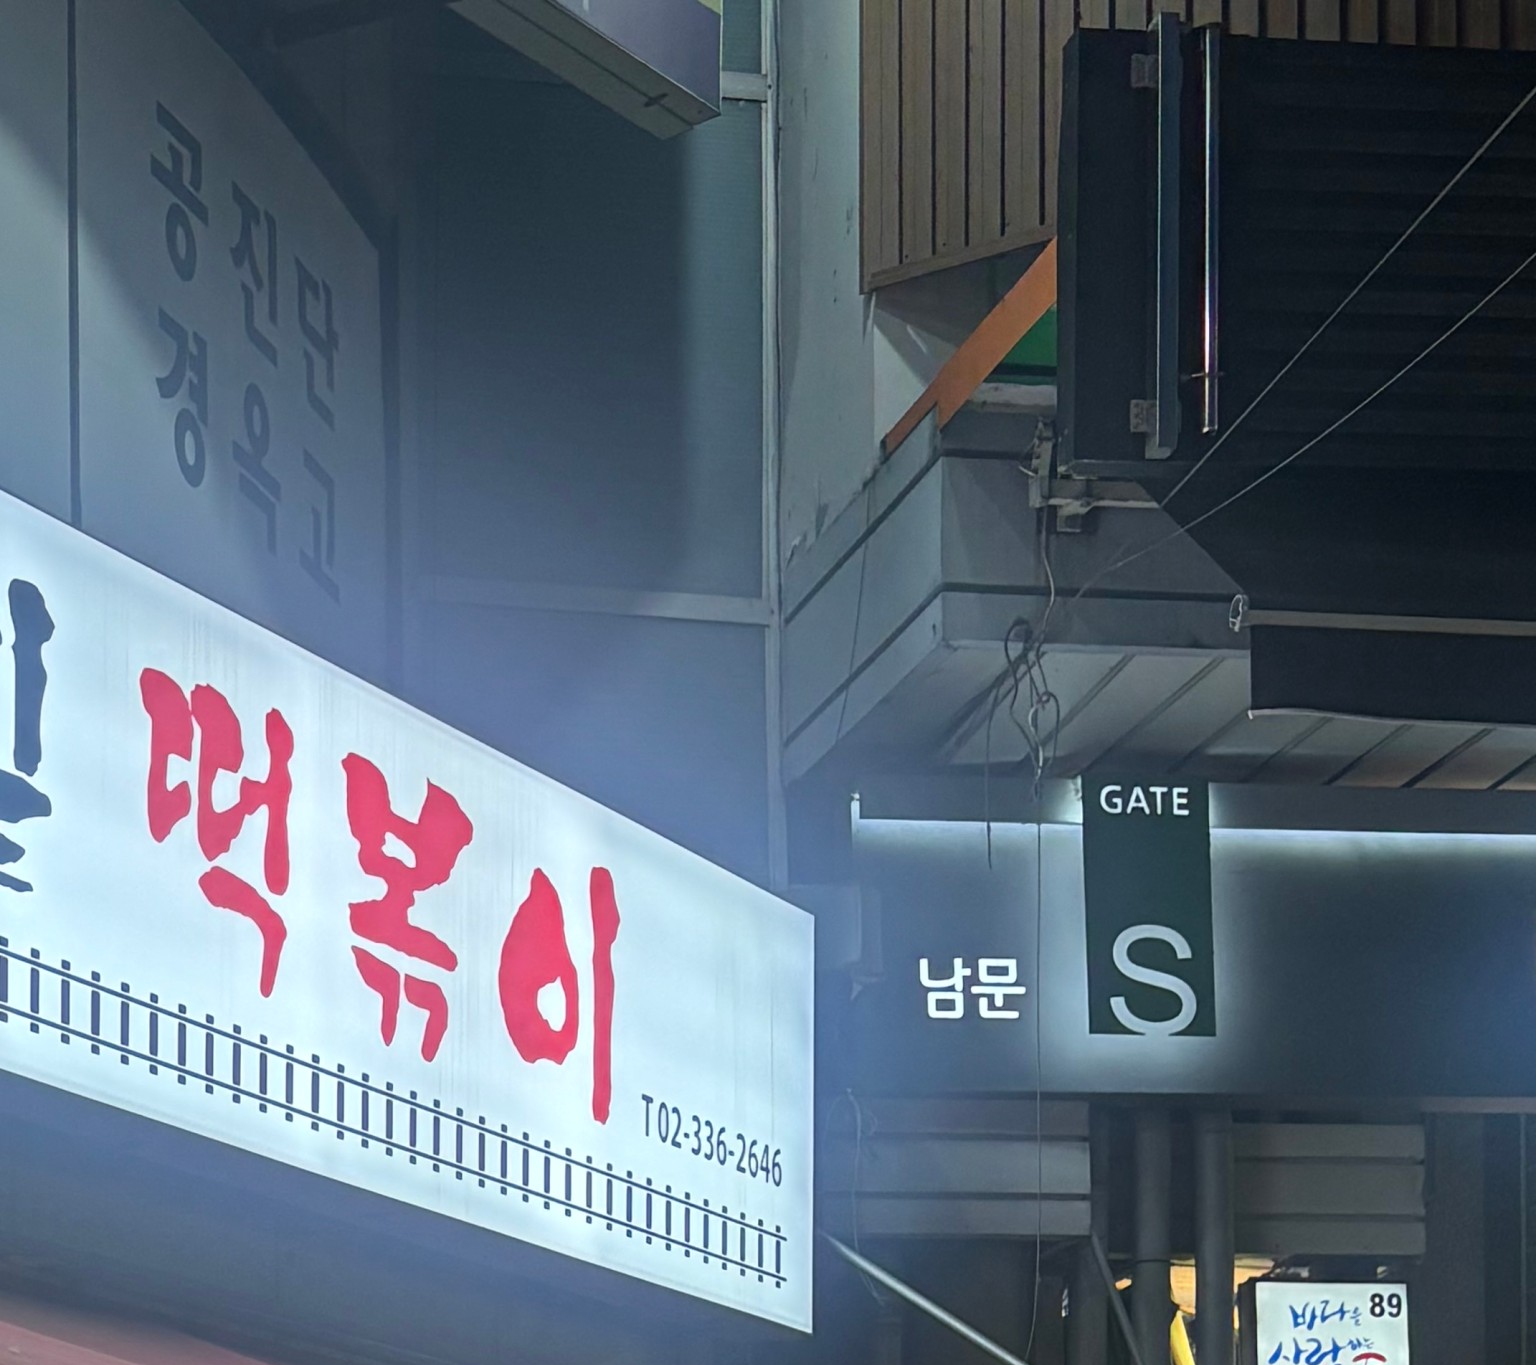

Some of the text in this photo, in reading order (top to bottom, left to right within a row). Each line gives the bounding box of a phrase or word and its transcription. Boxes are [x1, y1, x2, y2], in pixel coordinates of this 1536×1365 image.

[150, 100, 340, 432] 공진단
[1100, 784, 1190, 816] GATE
[140, 667, 621, 1125] 떡볶이
[919, 957, 1026, 1019] 남문
[1110, 924, 1197, 1037] S
[658, 1101, 782, 1187] 02-336-2646
[1369, 1293, 1402, 1318] 89
